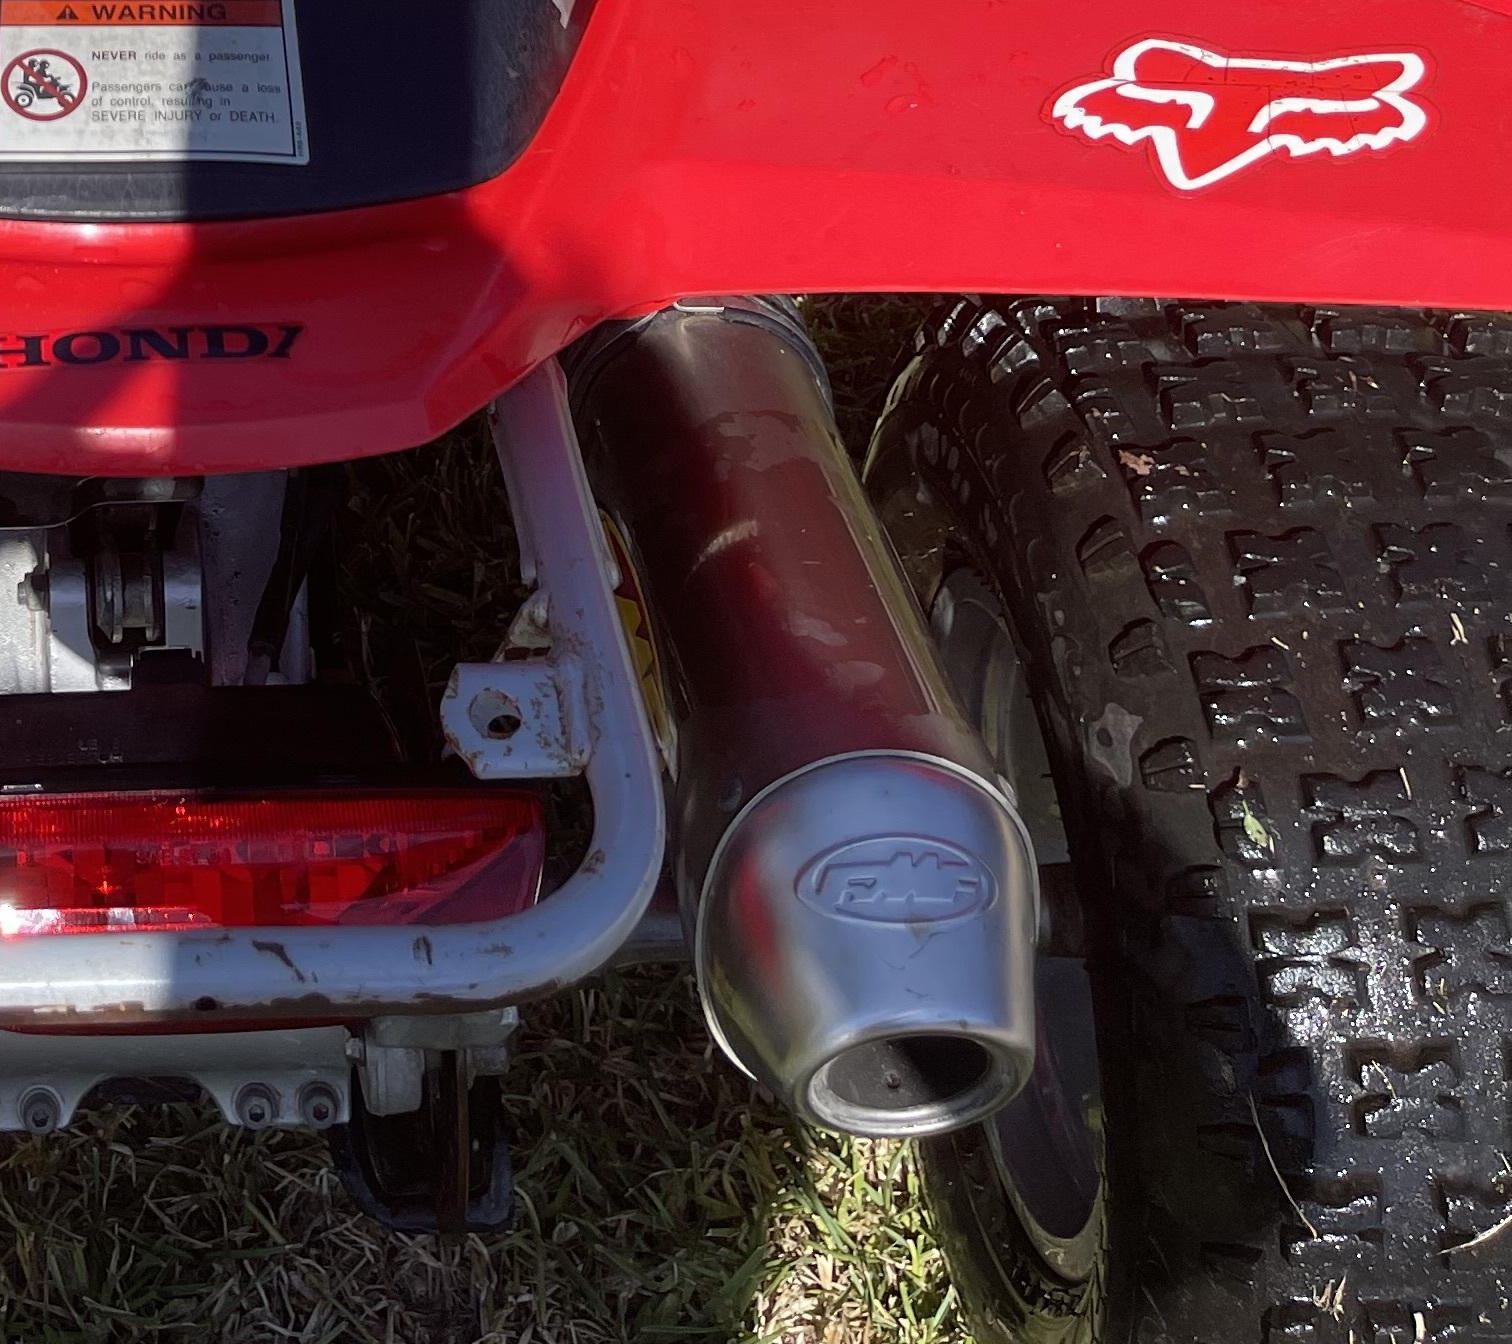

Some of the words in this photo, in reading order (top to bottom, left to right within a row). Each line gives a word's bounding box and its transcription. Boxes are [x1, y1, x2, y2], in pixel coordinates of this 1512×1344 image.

[91, 3, 227, 21] WARNING
[91, 49, 137, 61] NEVER
[144, 50, 165, 60] ride
[173, 52, 186, 60] as
[92, 81, 162, 94] Passengers
[256, 82, 281, 94] loss
[91, 95, 103, 107] of
[110, 95, 154, 107] control,
[220, 96, 231, 106] in
[92, 109, 146, 122] SEVERE
[154, 109, 202, 122] INJURY
[208, 112, 222, 121] or
